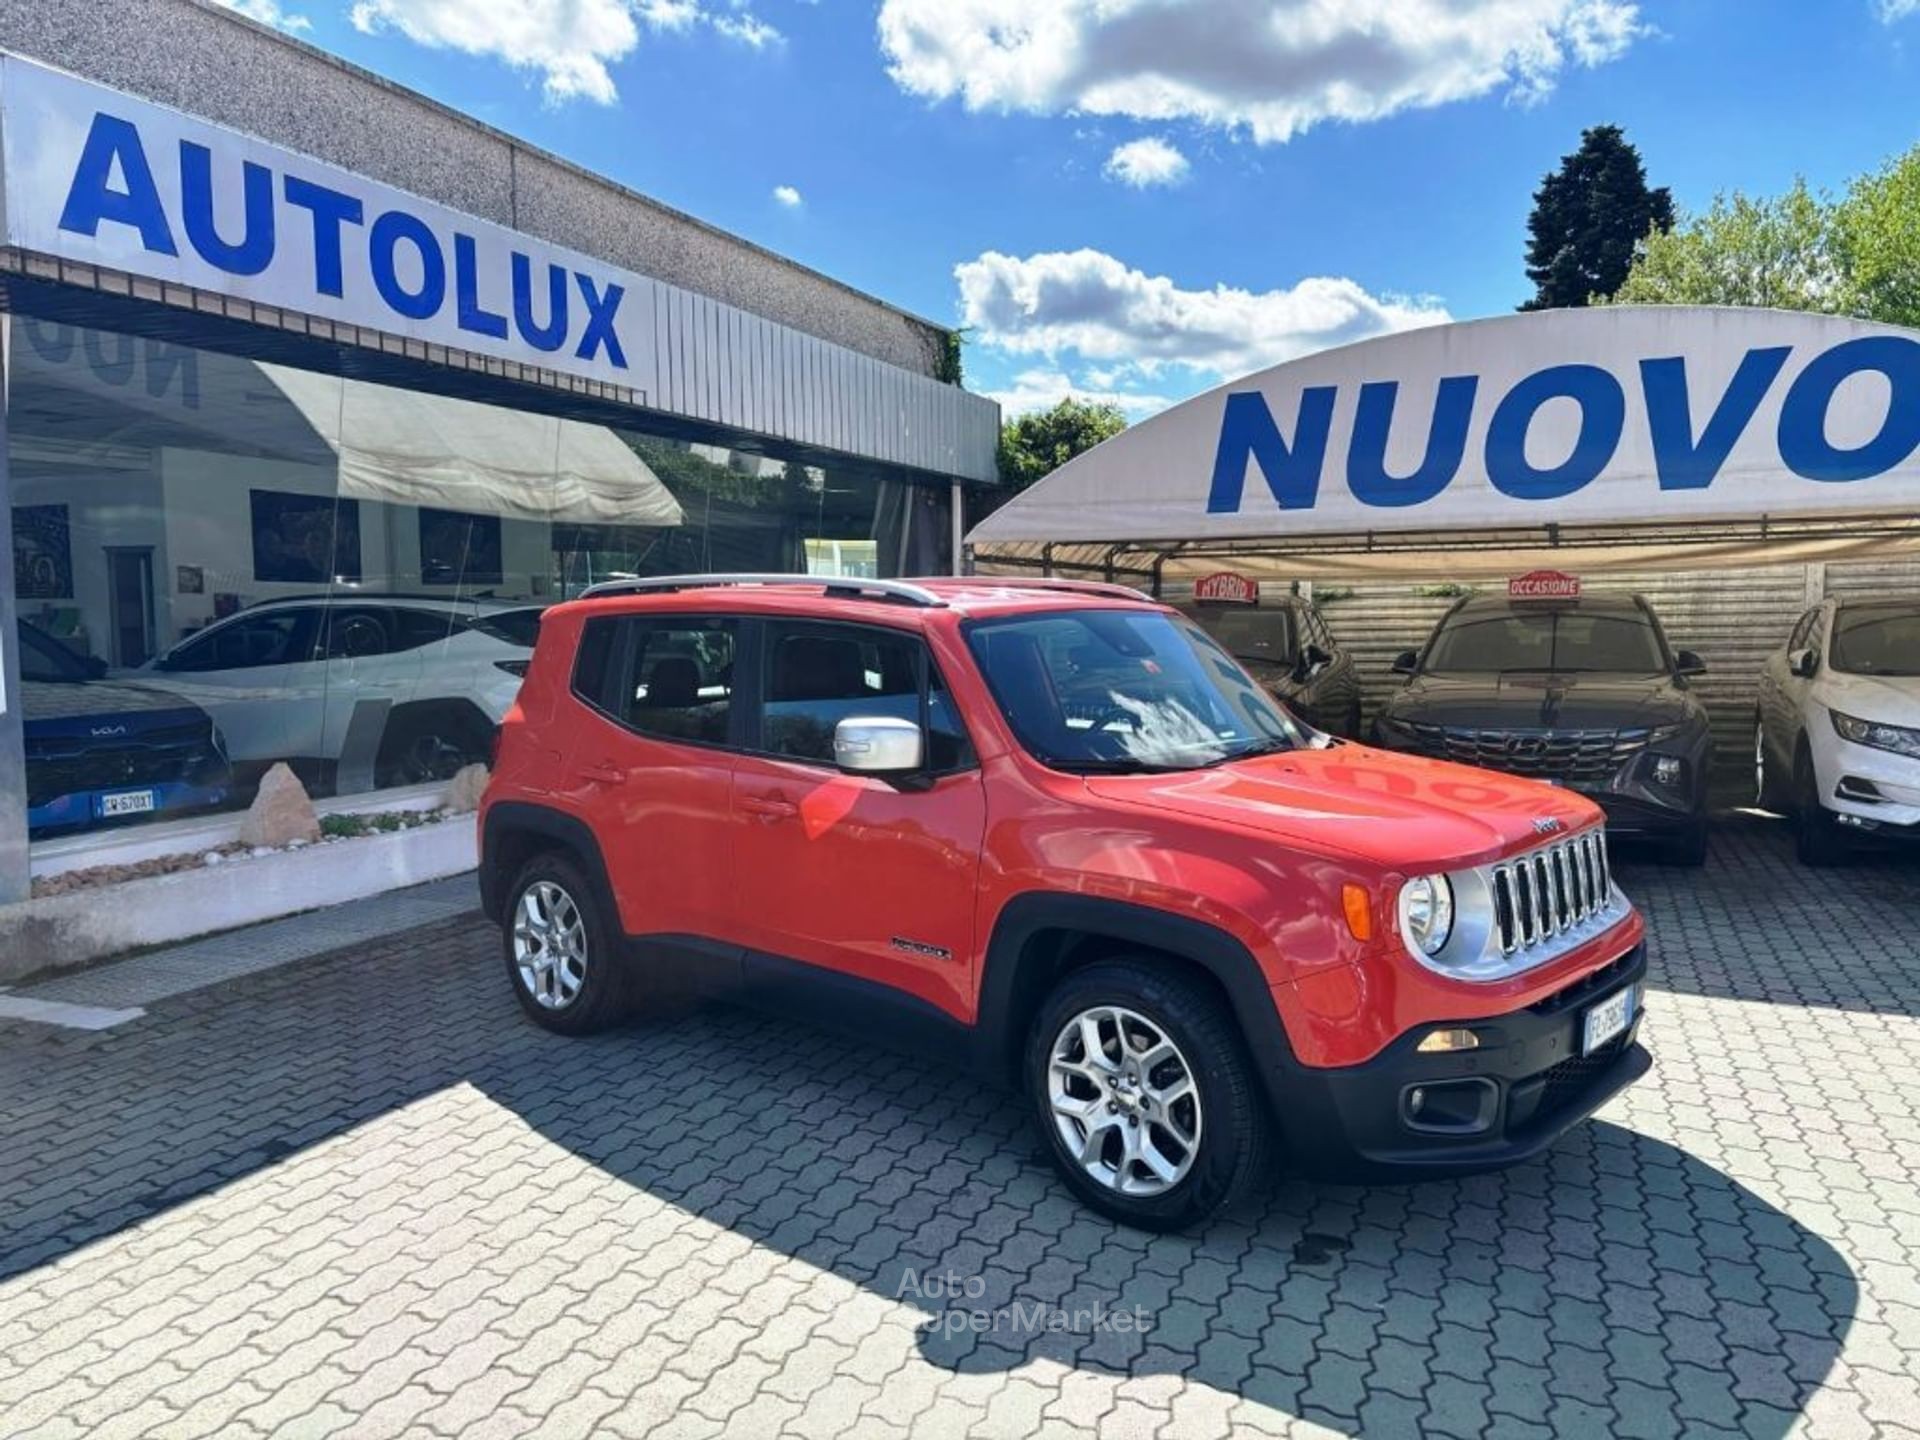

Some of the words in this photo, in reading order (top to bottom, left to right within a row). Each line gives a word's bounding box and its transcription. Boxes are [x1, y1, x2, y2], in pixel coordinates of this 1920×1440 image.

[58, 112, 628, 369] AUTOLUX
[1206, 336, 1920, 513] NUOVO
[1201, 575, 1248, 597] HYBRID
[1510, 580, 1577, 594] OCCASIONE
